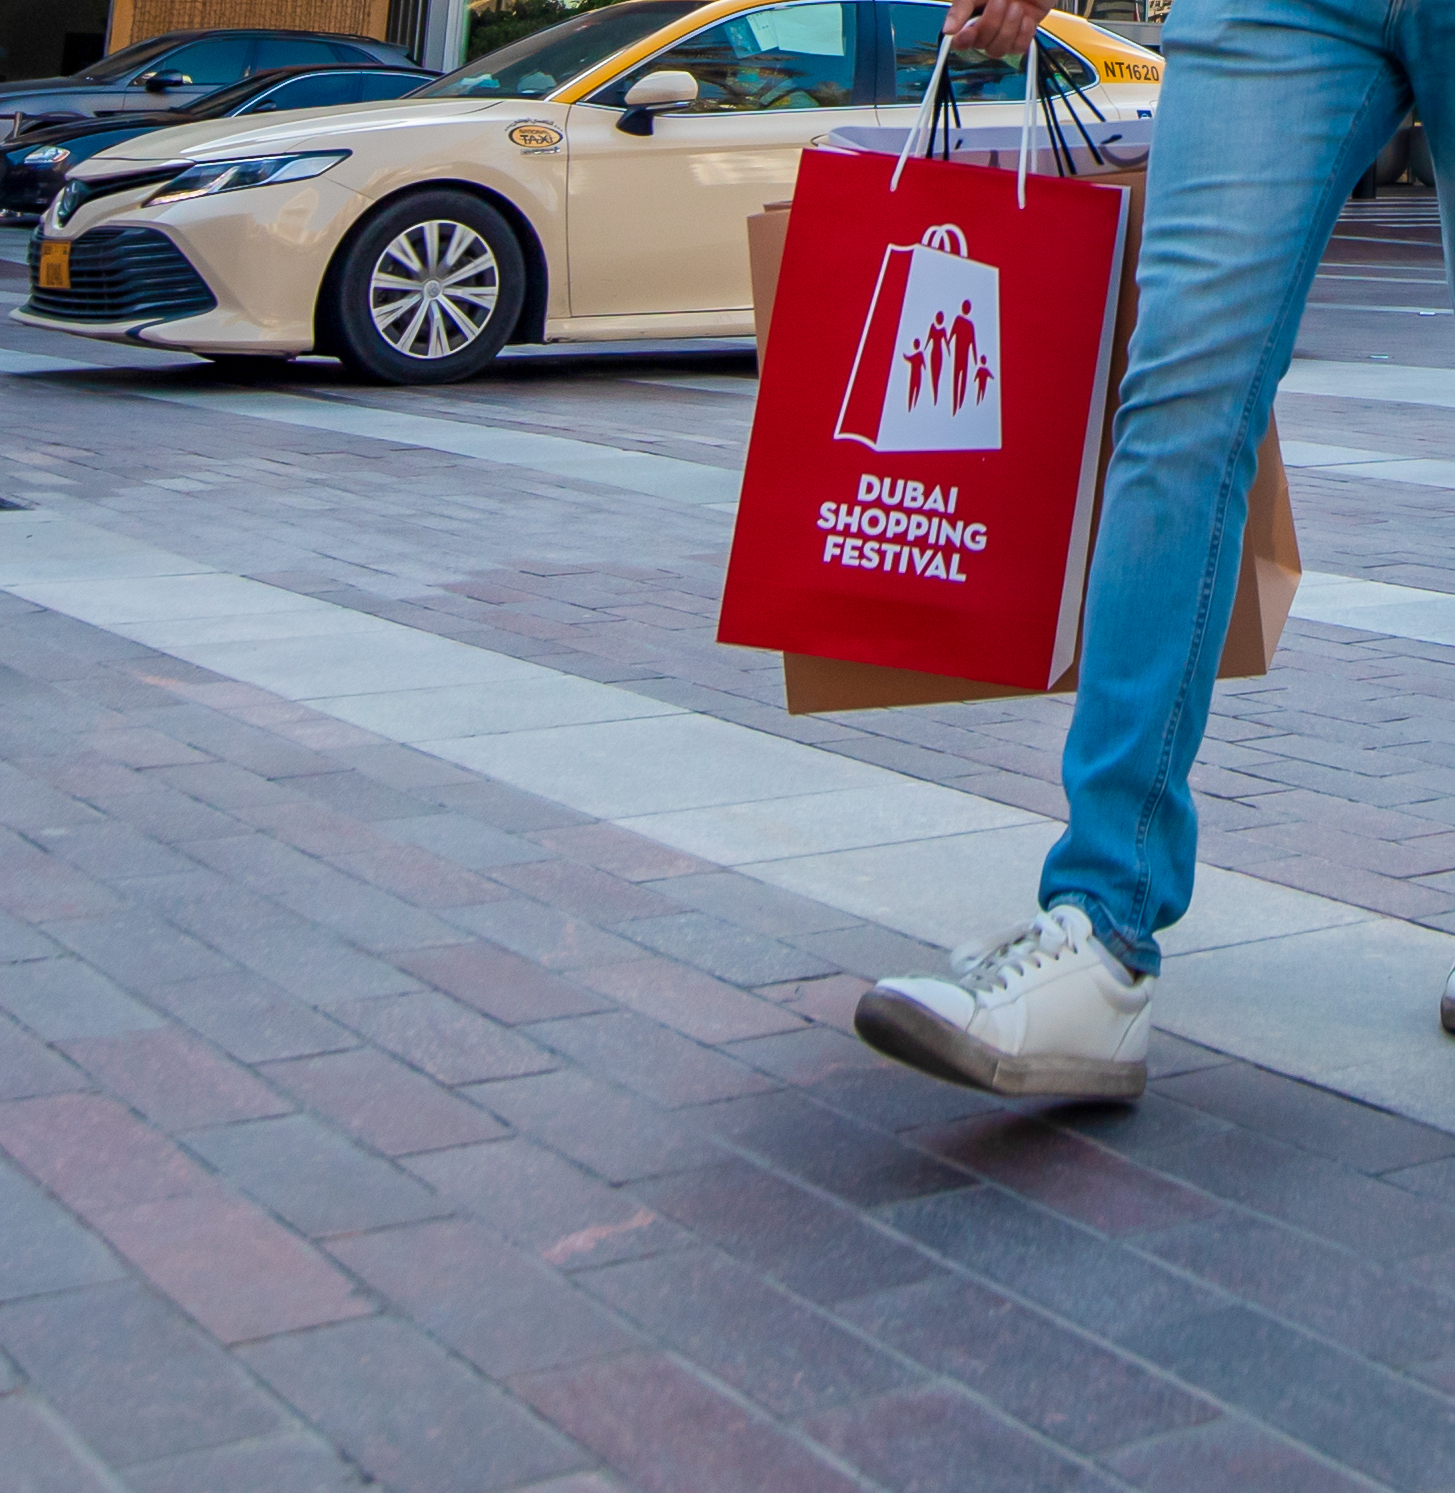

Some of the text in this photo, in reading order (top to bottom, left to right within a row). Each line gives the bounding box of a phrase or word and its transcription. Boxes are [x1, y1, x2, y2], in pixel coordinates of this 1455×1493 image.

[1104, 60, 1159, 82] NT1620
[519, 134, 554, 145] TAXI
[857, 473, 958, 514] DUBAI
[816, 500, 988, 551] SHOPPING
[823, 534, 967, 582] FESTIVAL
